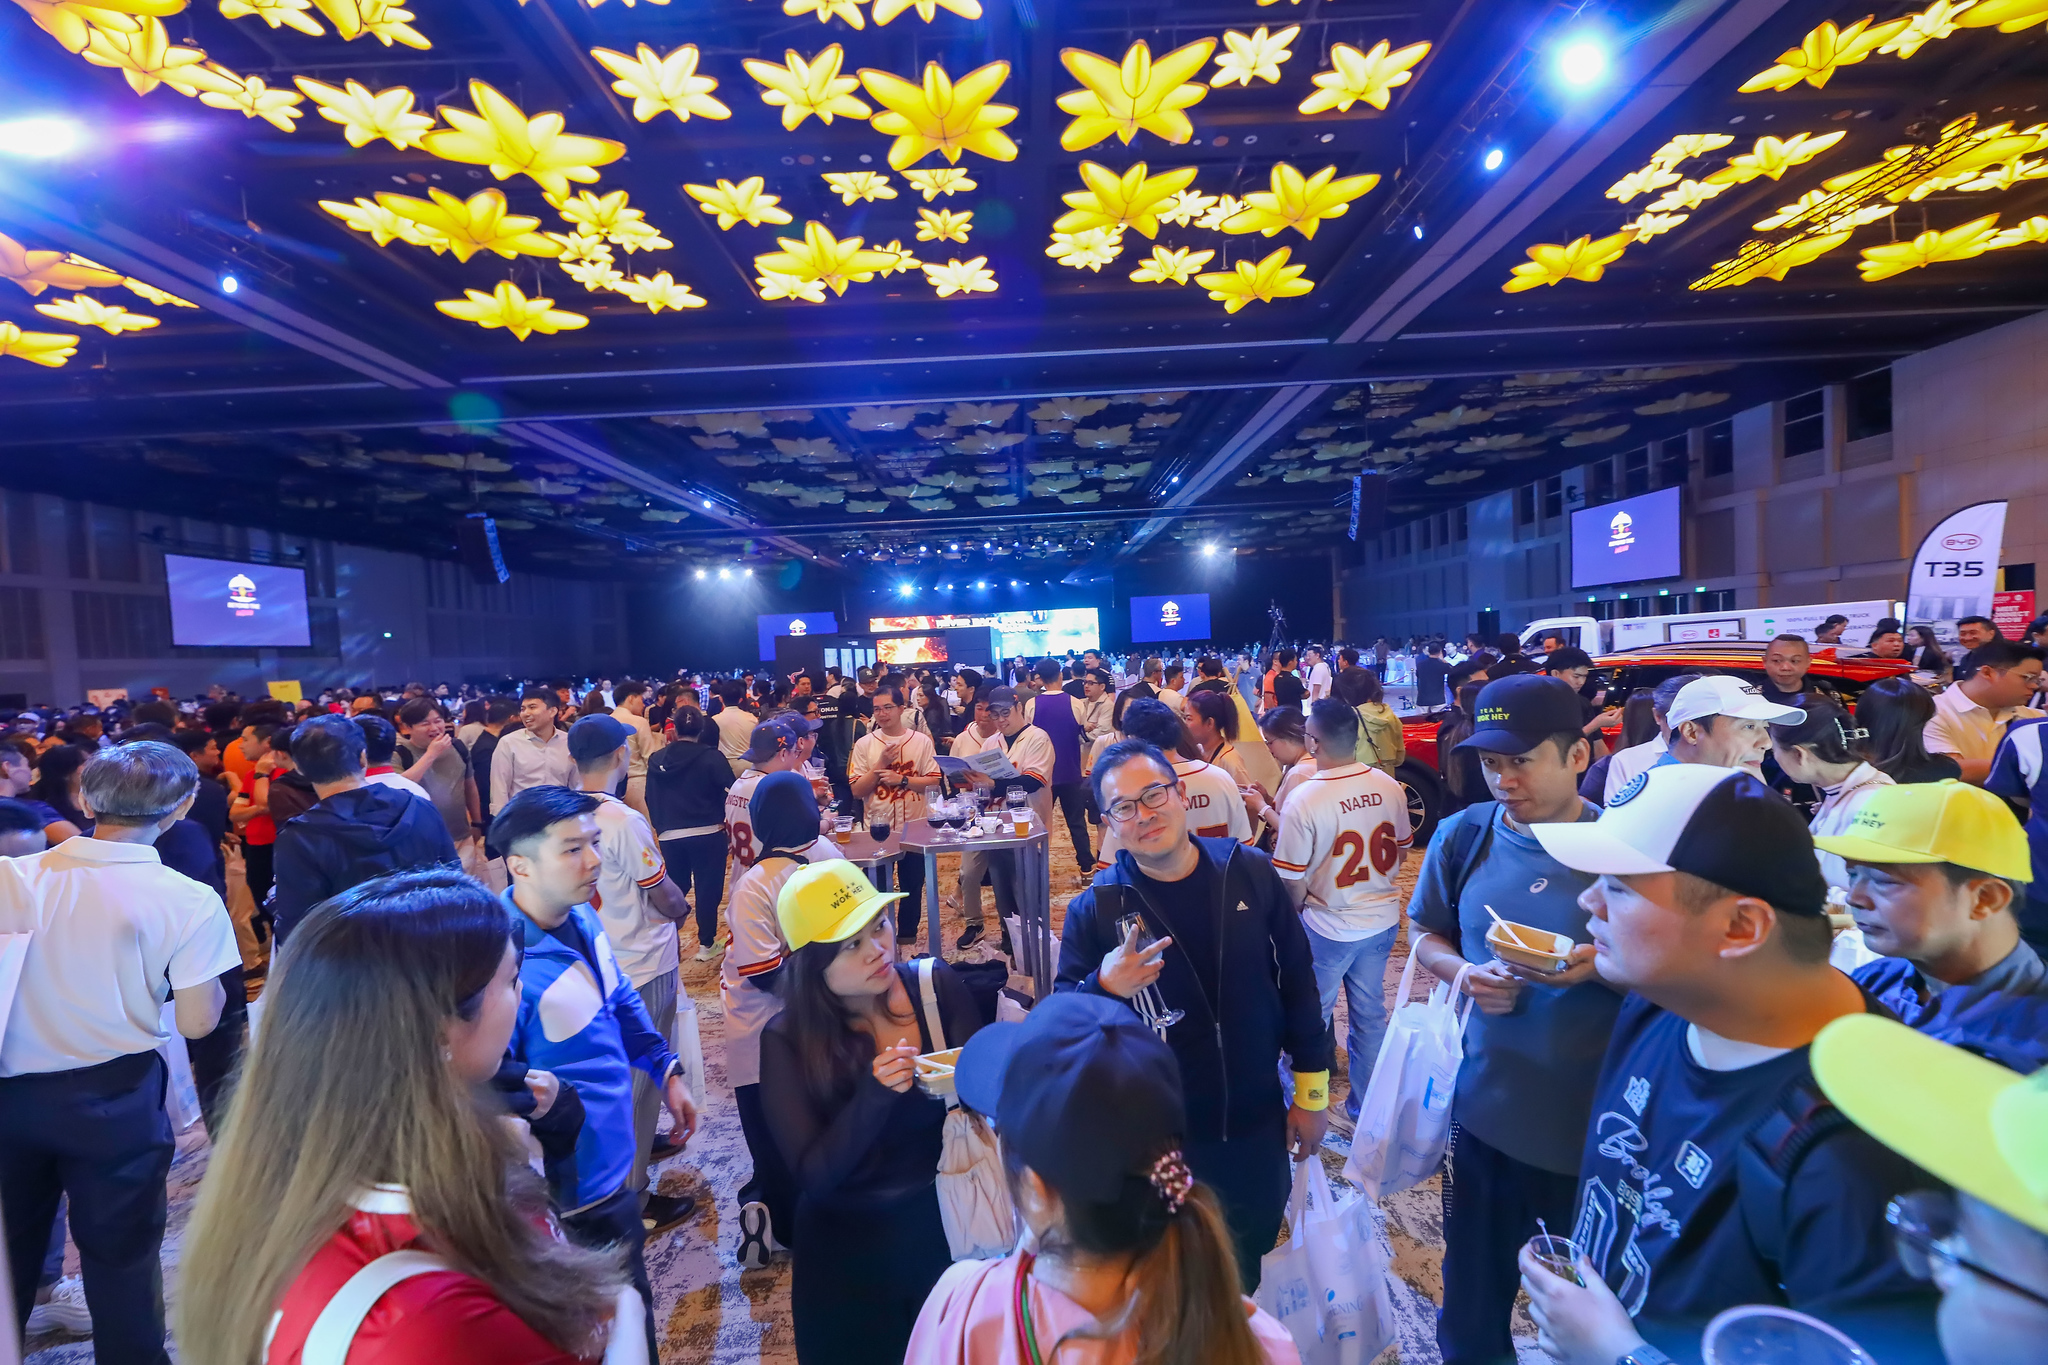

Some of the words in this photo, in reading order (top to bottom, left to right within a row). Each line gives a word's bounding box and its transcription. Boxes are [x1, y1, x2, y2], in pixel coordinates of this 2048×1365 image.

[1946, 538, 1978, 546] BYD
[1924, 561, 1984, 577] T35
[1185, 793, 1210, 811] MD
[1339, 792, 1383, 814] NARD
[1332, 820, 1398, 890] 26
[830, 892, 852, 909] WOK
[851, 885, 864, 895] HEY
